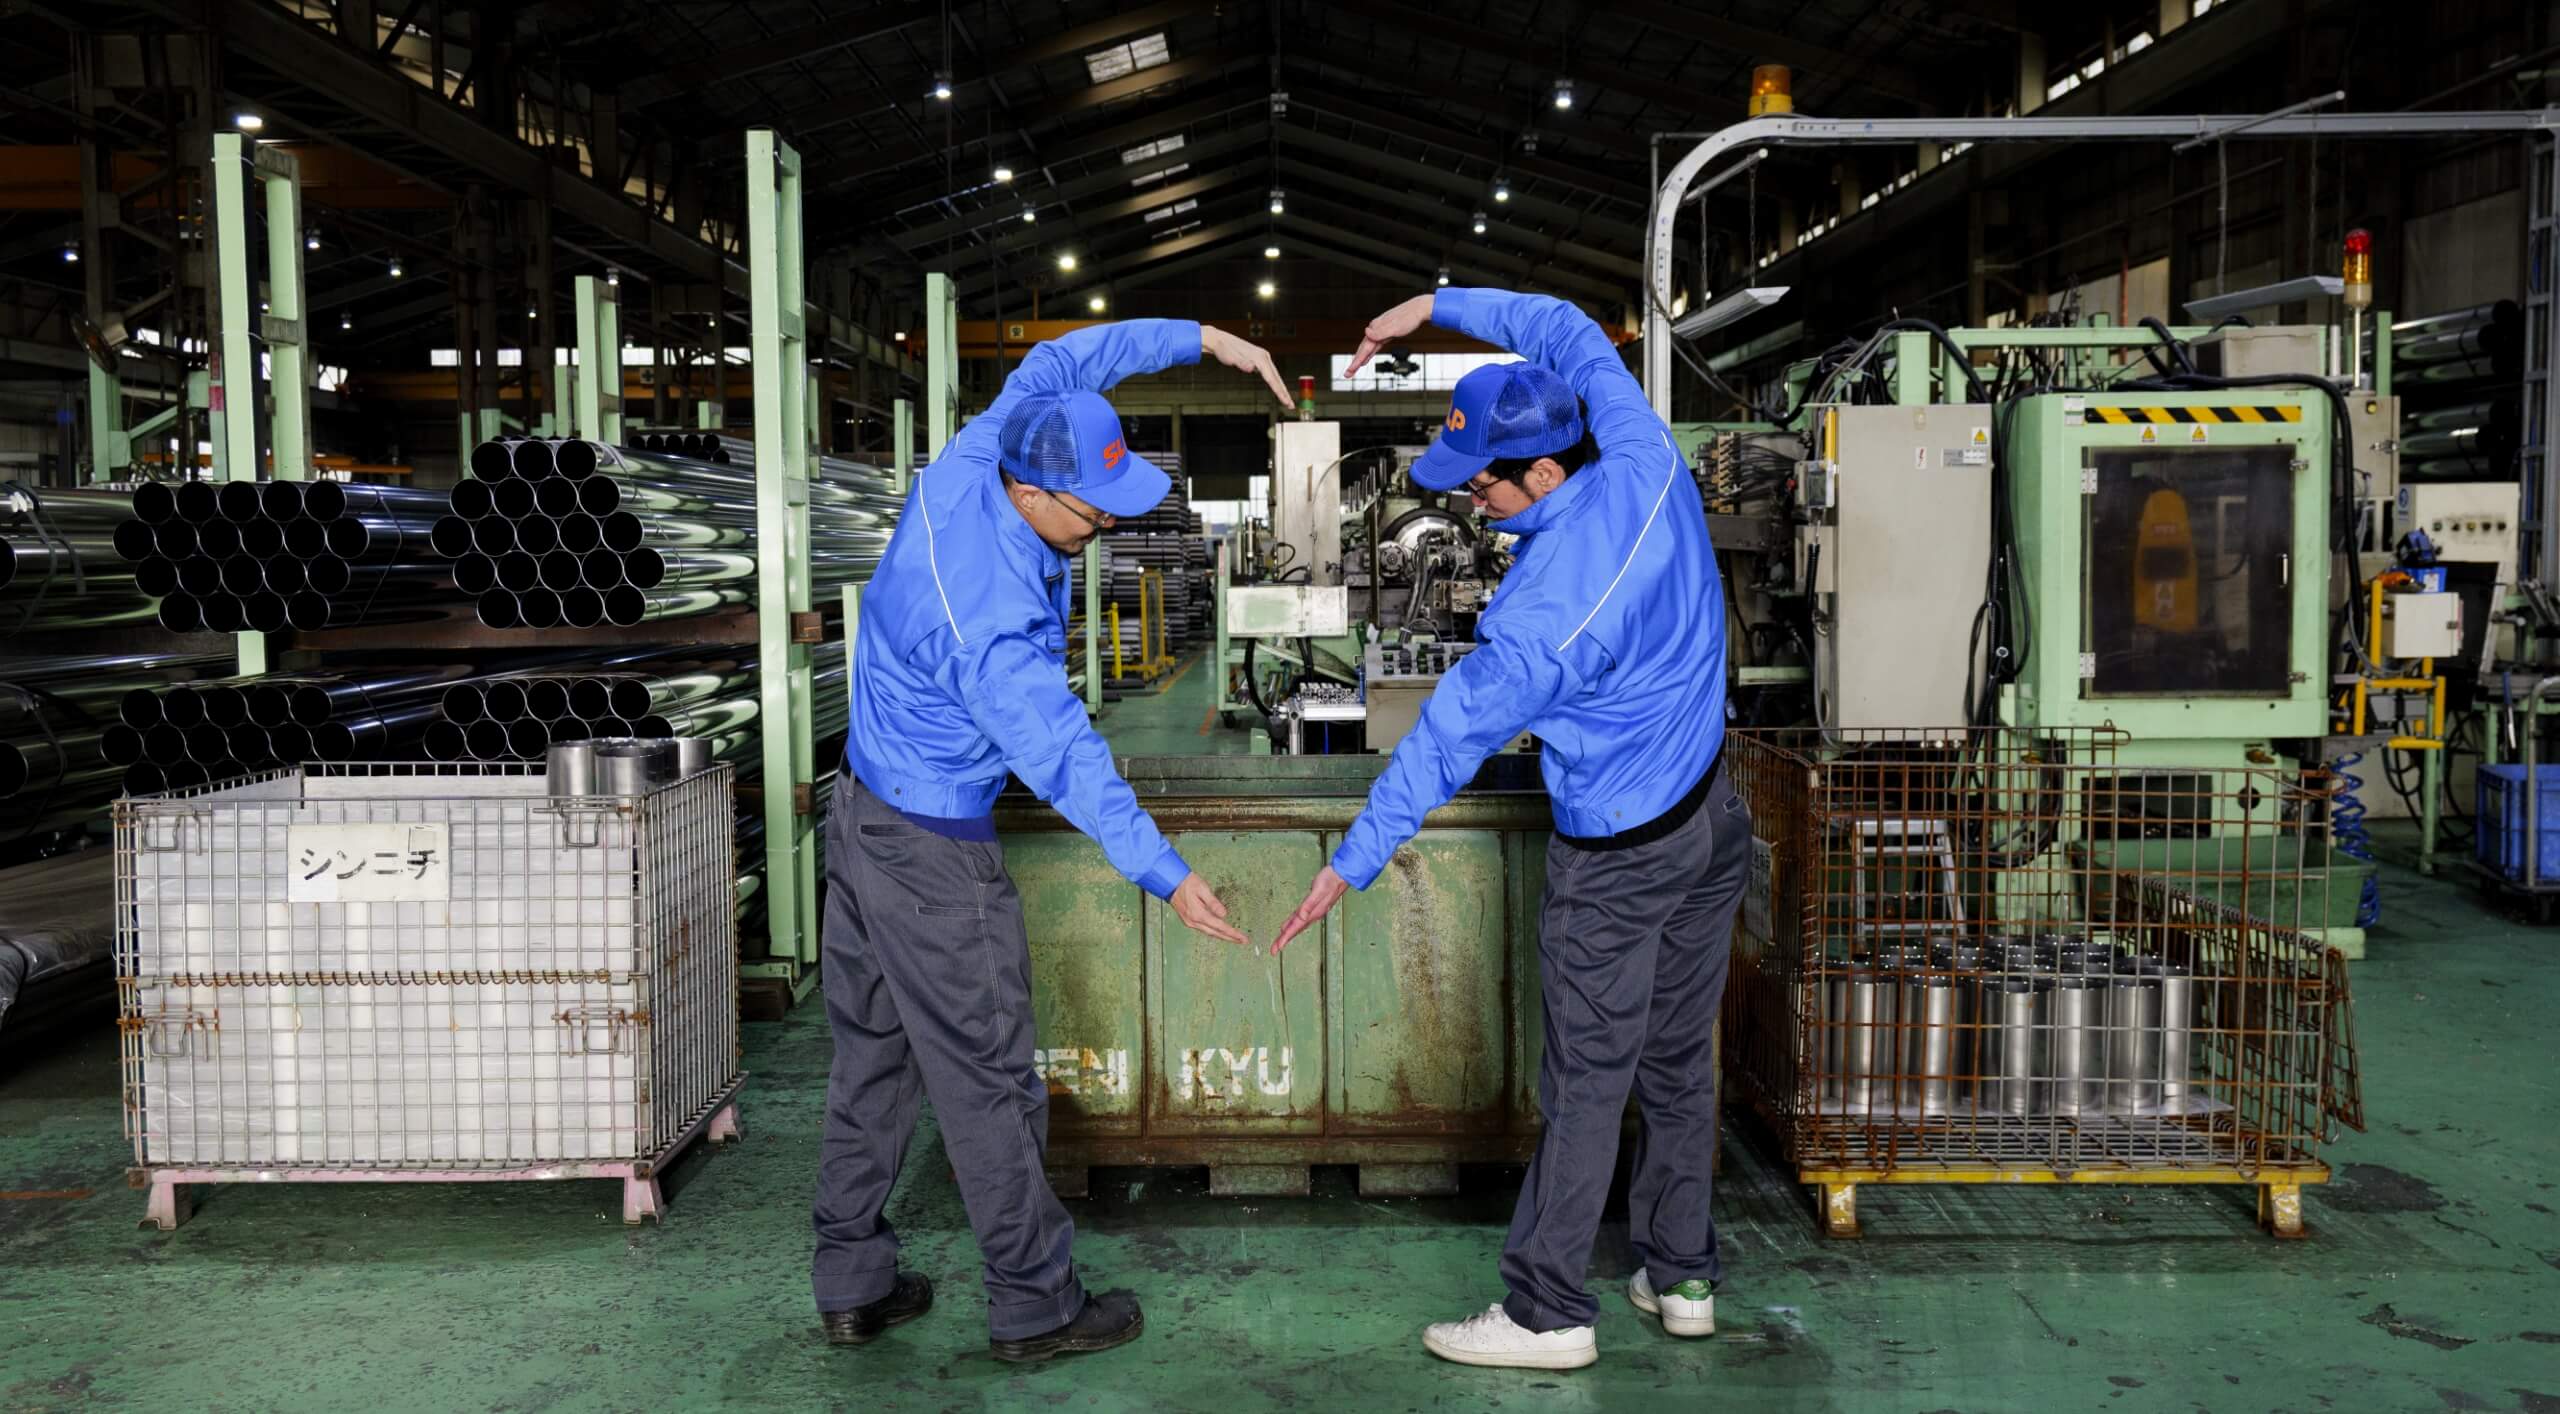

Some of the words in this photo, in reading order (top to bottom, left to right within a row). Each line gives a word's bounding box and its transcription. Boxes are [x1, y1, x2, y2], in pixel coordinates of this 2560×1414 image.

[300, 849, 440, 880] シンニチ
[1180, 1046, 1291, 1099] KYU
